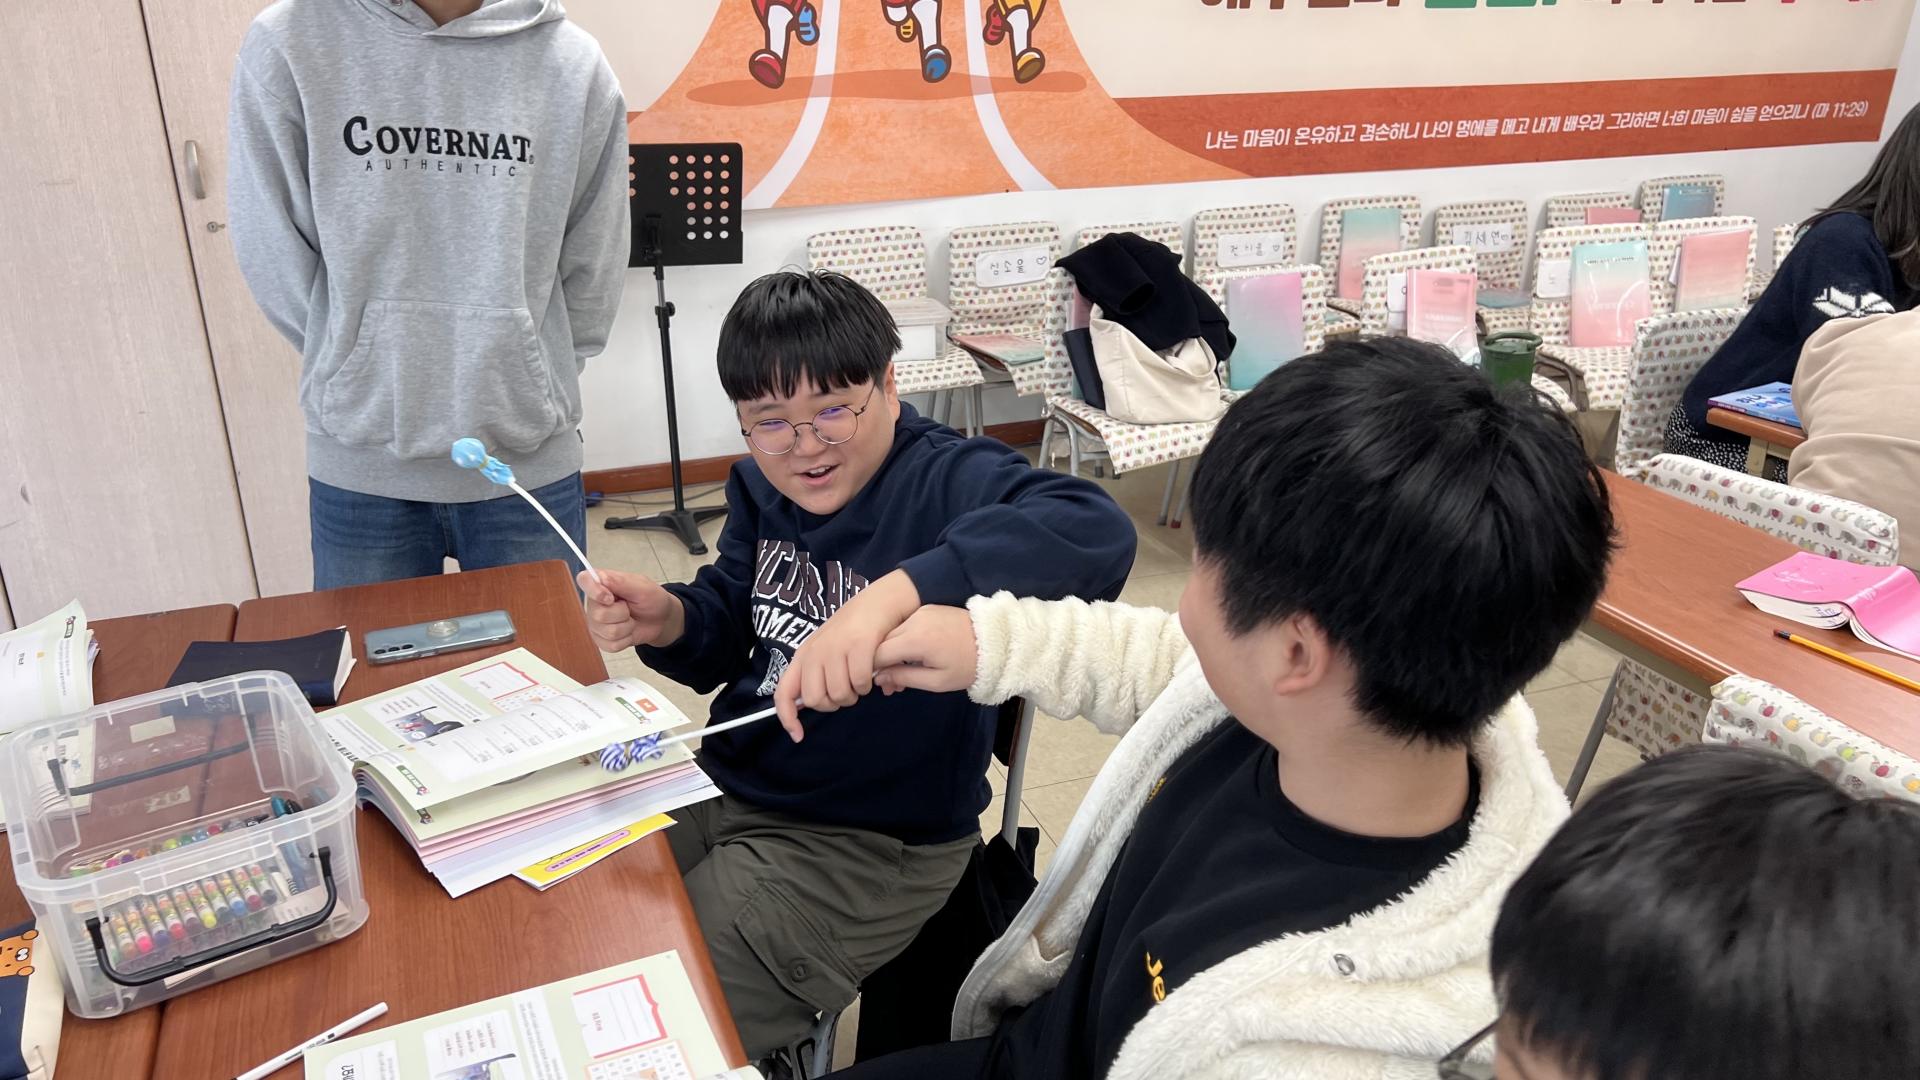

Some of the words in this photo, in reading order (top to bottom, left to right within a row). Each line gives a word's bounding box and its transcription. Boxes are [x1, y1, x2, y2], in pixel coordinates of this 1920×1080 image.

[343, 115, 531, 162] COVERNAT
[1206, 131, 1238, 149] 나는
[1243, 128, 1290, 147] 마음이
[1294, 124, 1356, 145] 온유하고
[1360, 122, 1420, 142] 겸손하니
[1422, 120, 1452, 138] 나의
[1456, 118, 1499, 137] 멍에를
[1501, 117, 1530, 135] 메고
[1532, 115, 1561, 133] 내게
[1563, 114, 1604, 132] 배우라
[1606, 111, 1661, 129] 그리하면
[1662, 110, 1689, 126] 너희
[1690, 107, 1729, 125] 마음이
[1730, 105, 1757, 123] 쉼을
[1758, 103, 1810, 122] 얻으리니
[365, 159, 516, 177] AUTHENTIC
